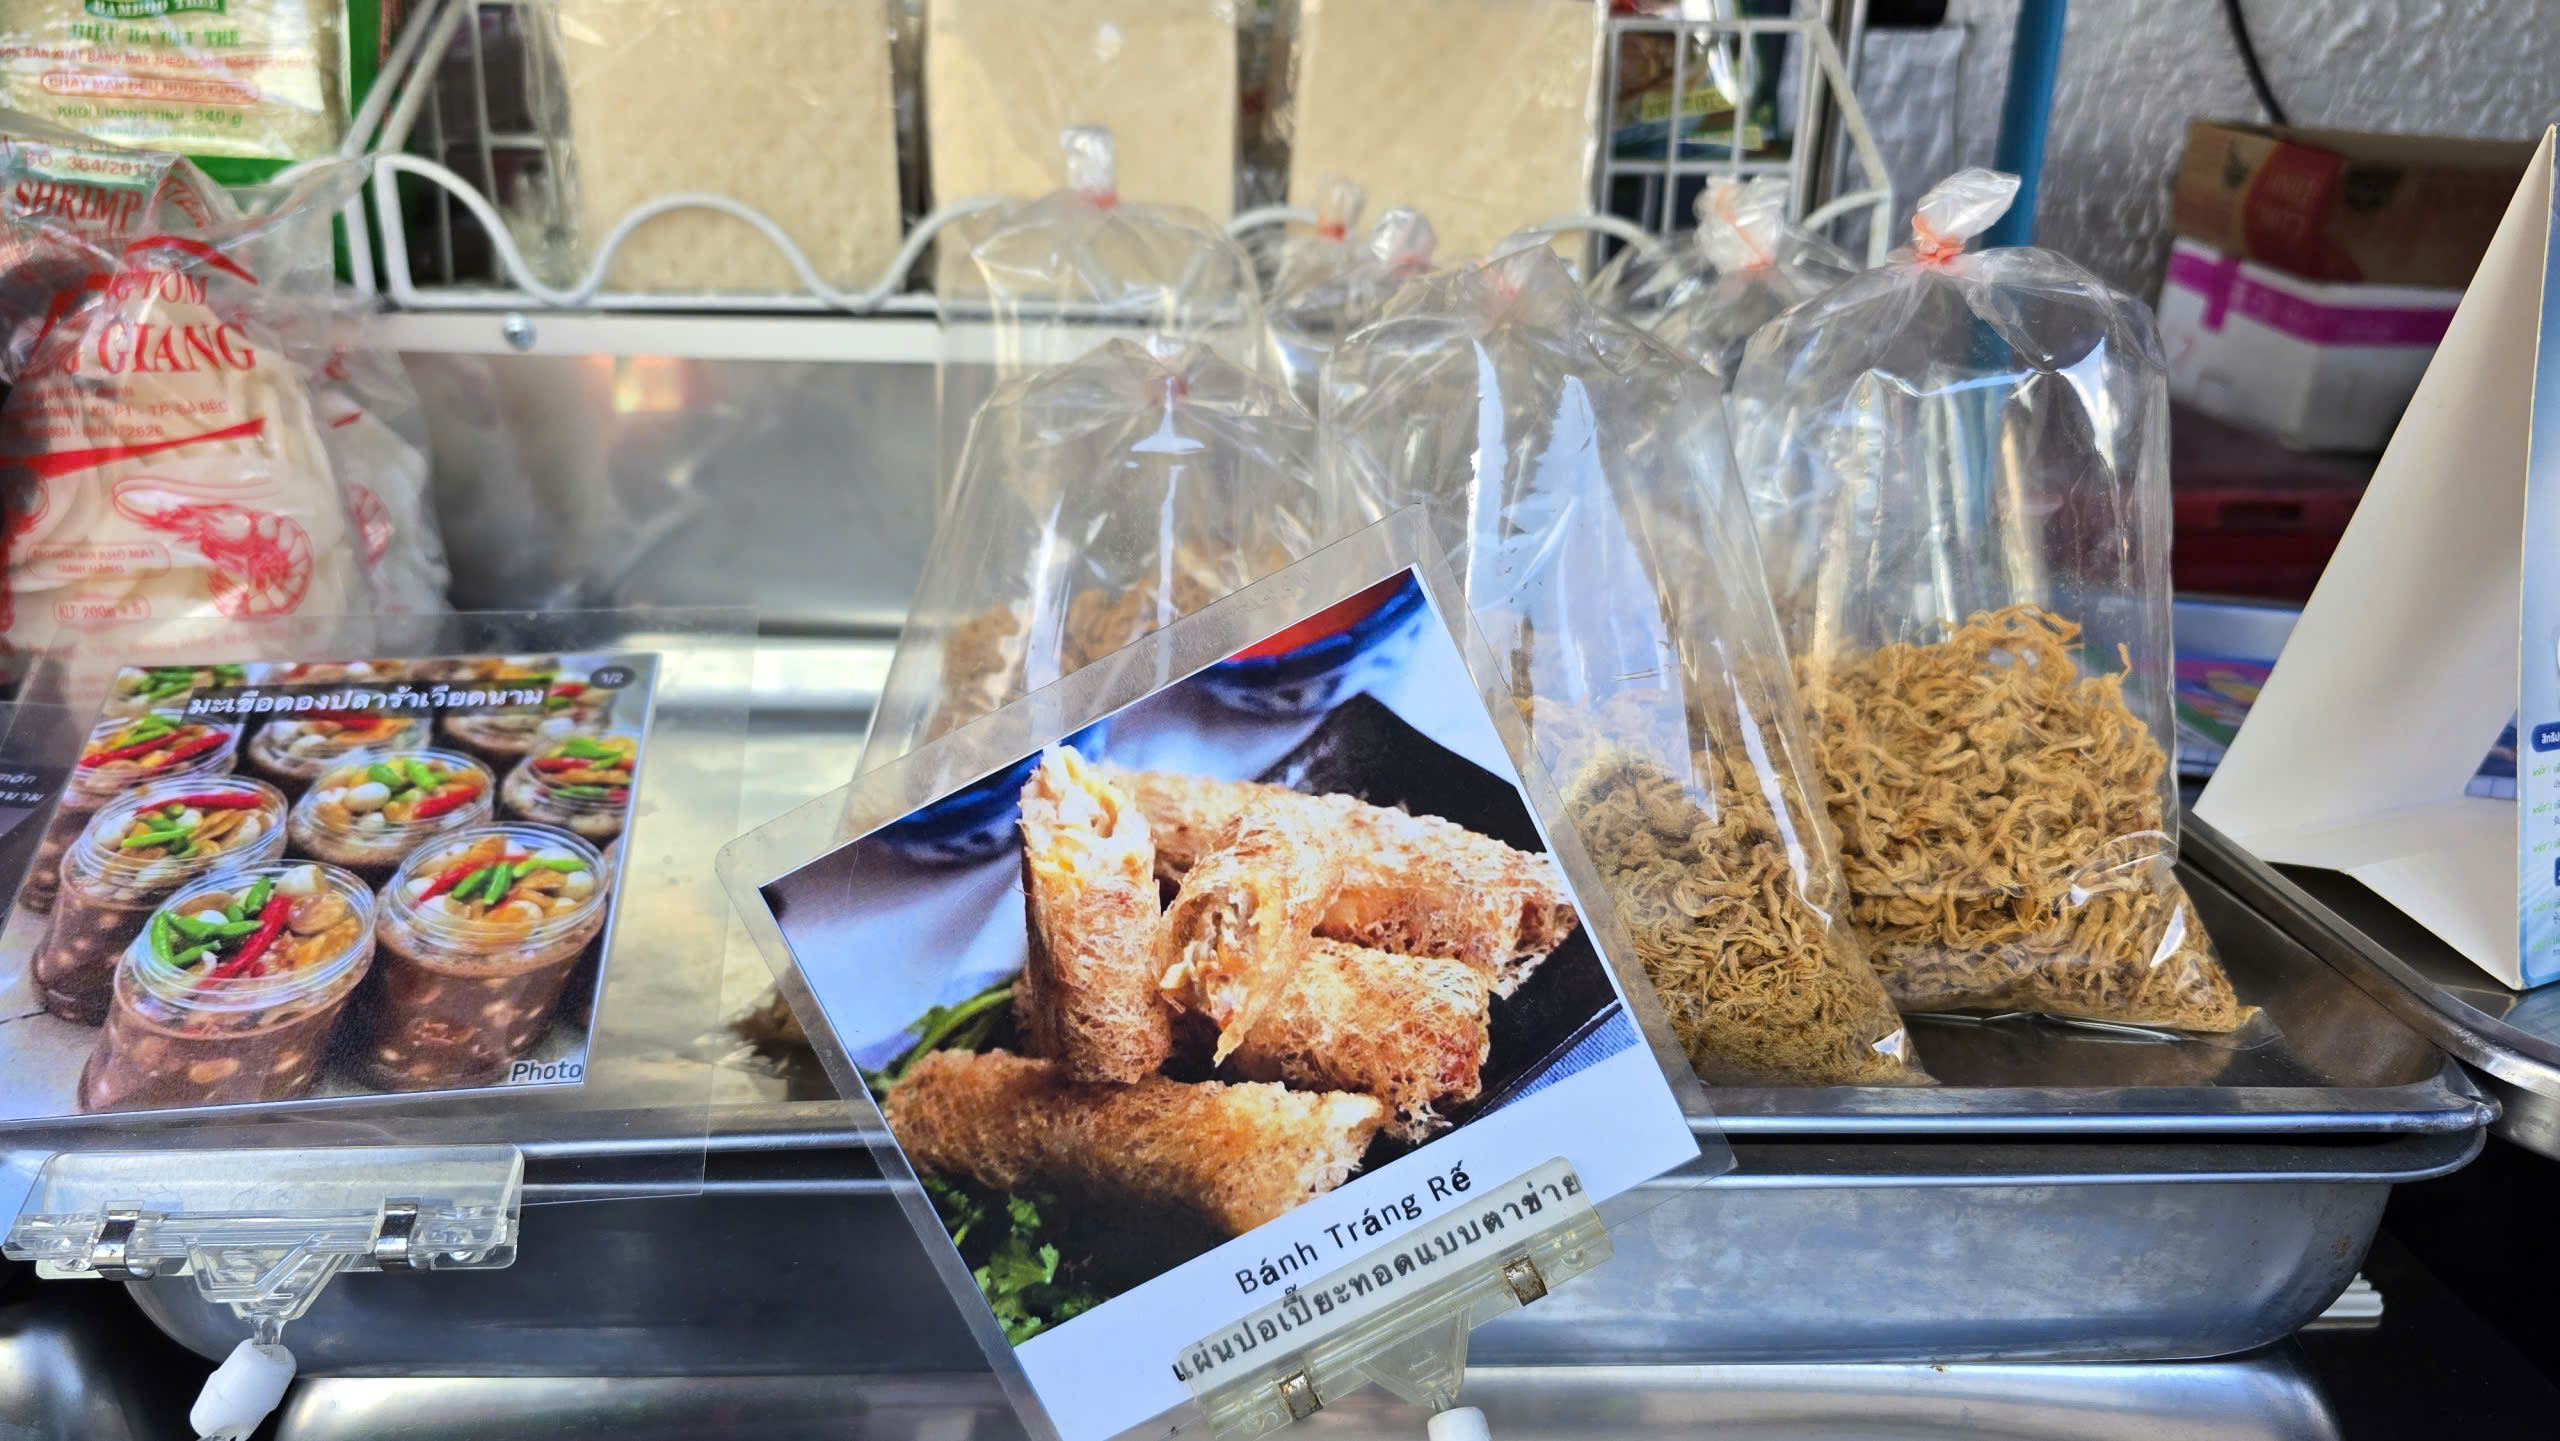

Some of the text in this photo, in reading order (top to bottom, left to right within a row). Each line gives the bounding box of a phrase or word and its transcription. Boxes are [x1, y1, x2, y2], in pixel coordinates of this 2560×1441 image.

[15, 178, 143, 233] SHRIMP
[98, 321, 257, 375] GIANG
[511, 1061, 582, 1081] Photo
[1235, 1159, 1471, 1295] Bánh Tráng Rế
[1172, 1173, 1583, 1382] แผ่นปอเปี๊ยะทอดแบบตาข่าย
